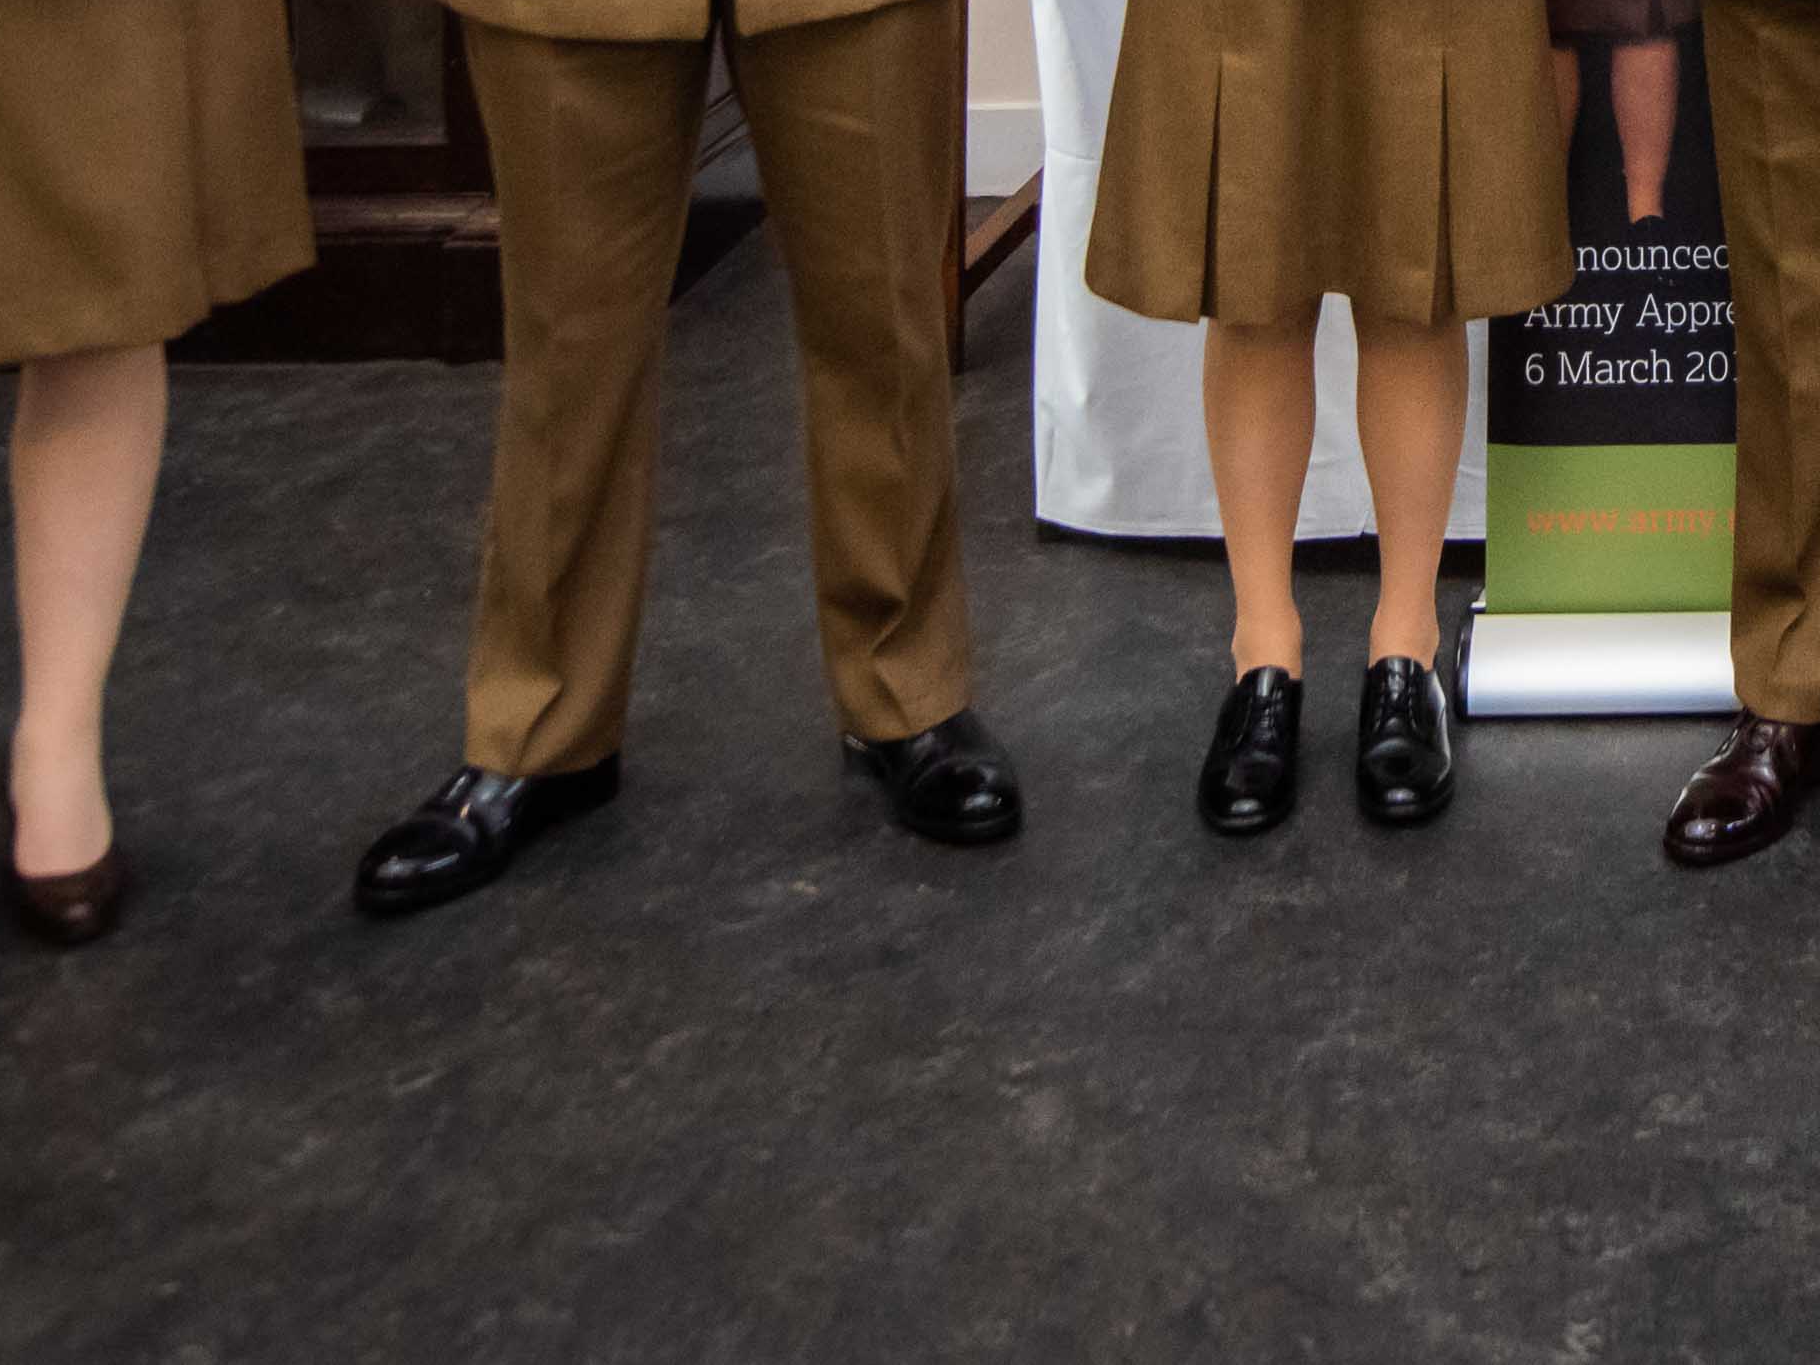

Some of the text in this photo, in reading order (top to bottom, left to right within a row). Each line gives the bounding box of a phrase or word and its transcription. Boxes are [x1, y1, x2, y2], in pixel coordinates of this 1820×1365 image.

[1524, 302, 1624, 335] Army
[1525, 349, 1738, 385] 6 March 20
